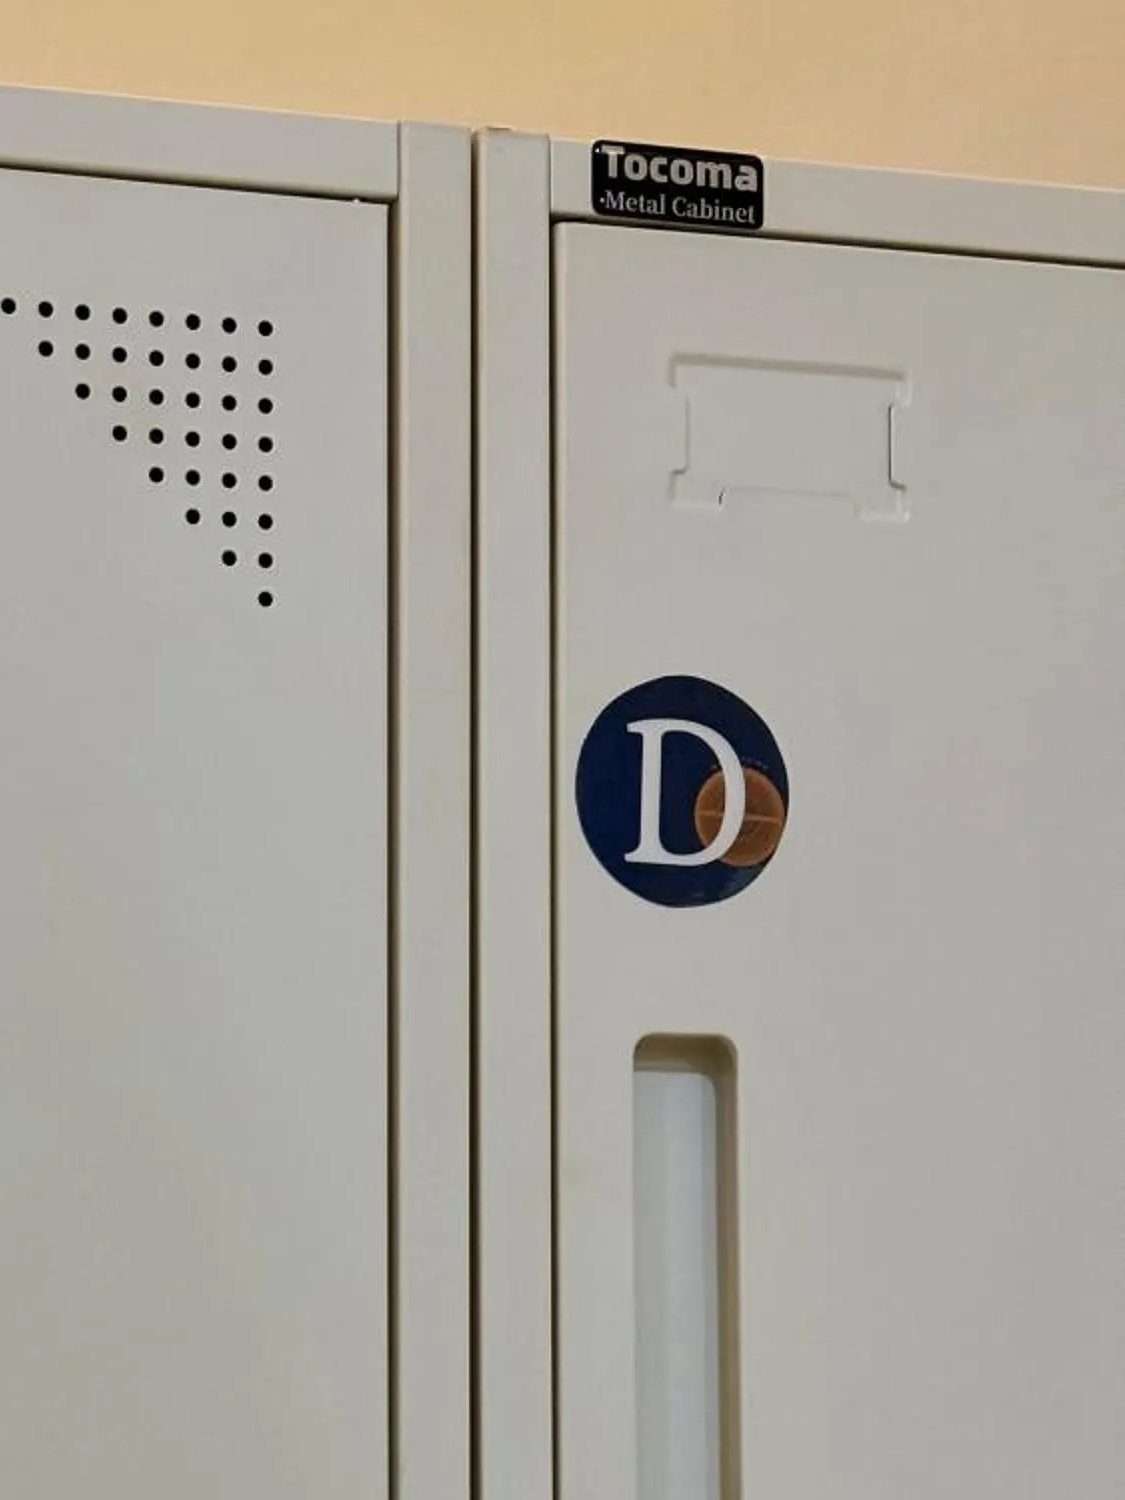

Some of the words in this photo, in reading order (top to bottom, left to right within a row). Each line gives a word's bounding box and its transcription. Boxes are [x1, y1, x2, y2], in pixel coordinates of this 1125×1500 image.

[601, 145, 758, 192] Tocoma
[605, 189, 665, 215] Metal
[672, 196, 756, 224] Cabinet
[624, 717, 746, 866] D
